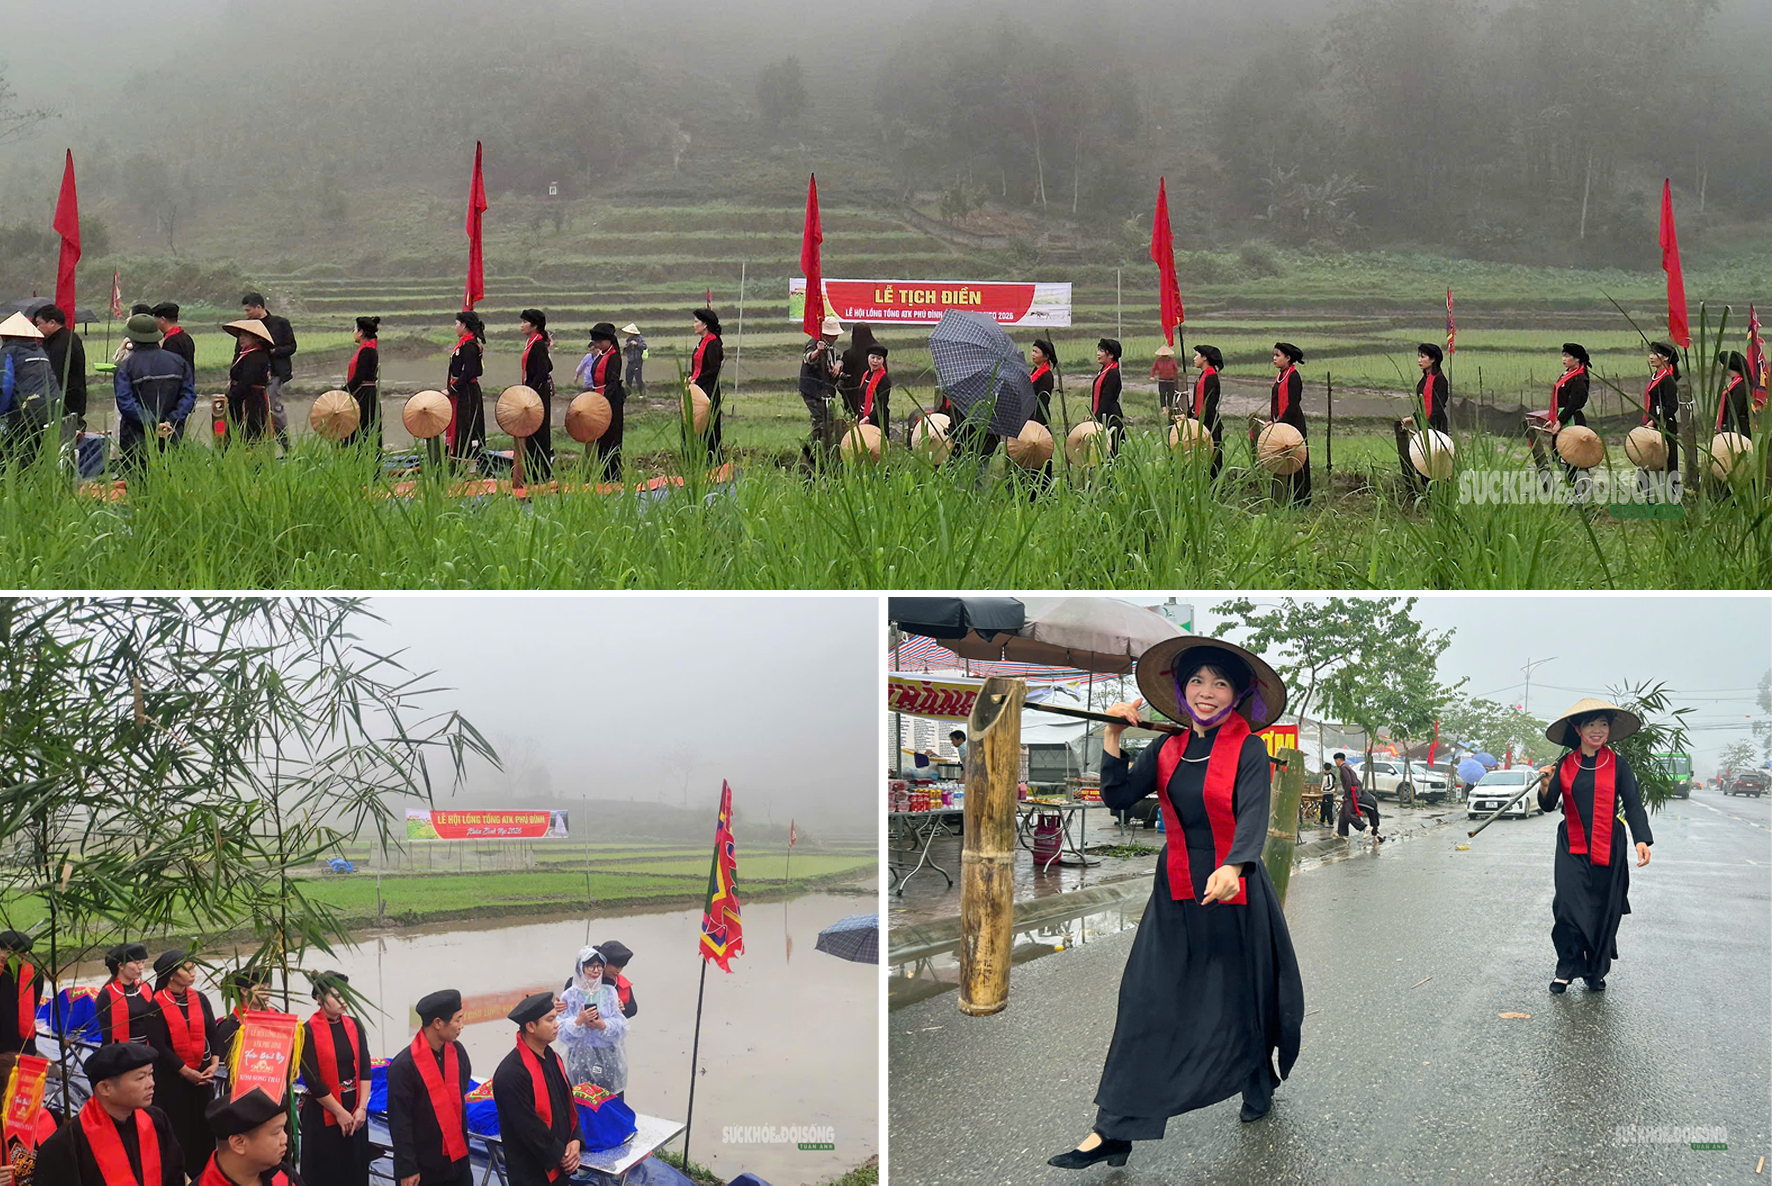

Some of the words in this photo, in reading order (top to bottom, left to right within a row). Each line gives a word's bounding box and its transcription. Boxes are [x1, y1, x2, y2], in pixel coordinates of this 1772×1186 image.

[875, 285, 894, 303] LỄ
[898, 290, 937, 306] TỊCH
[941, 286, 981, 305] ĐIỀN
[901, 310, 913, 318] ATK
[998, 312, 1014, 320] 2026
[502, 815, 514, 824] ATK
